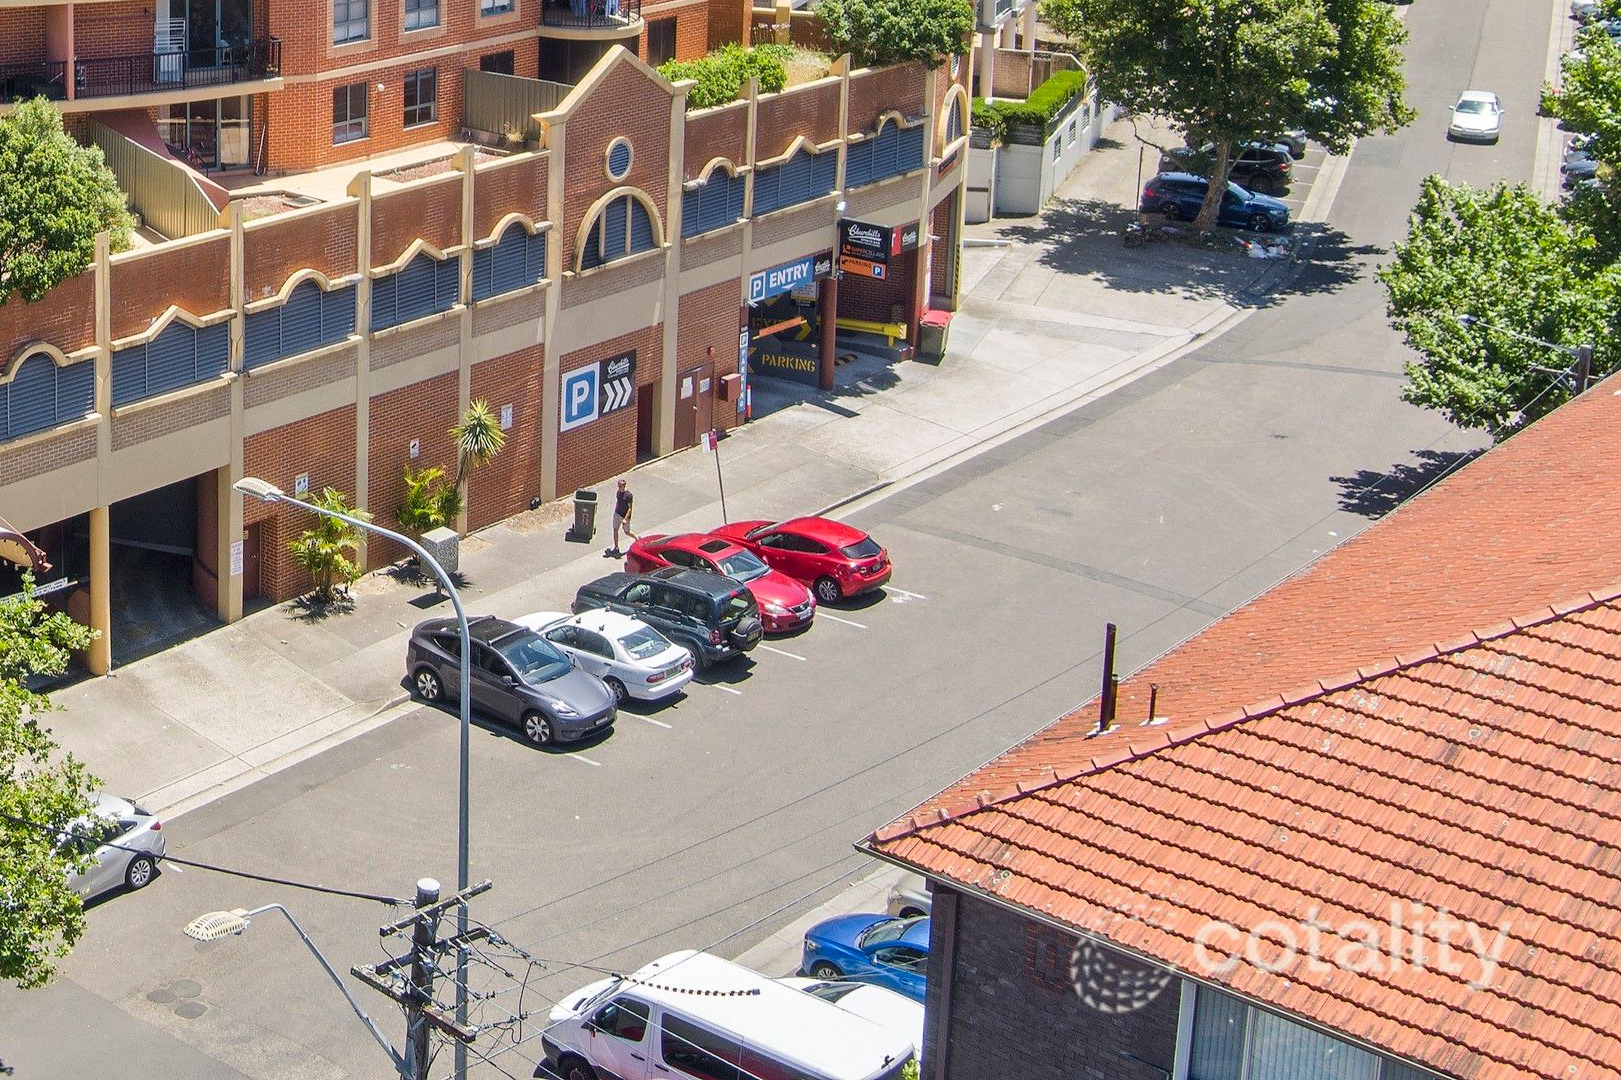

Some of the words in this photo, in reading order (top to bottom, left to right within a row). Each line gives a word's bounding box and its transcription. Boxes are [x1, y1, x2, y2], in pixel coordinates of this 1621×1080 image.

[847, 259, 872, 269] PARKING
[753, 279, 762, 297] P
[769, 262, 809, 288] ENTRY
[761, 354, 816, 372] PARKING
[571, 380, 590, 417] P
